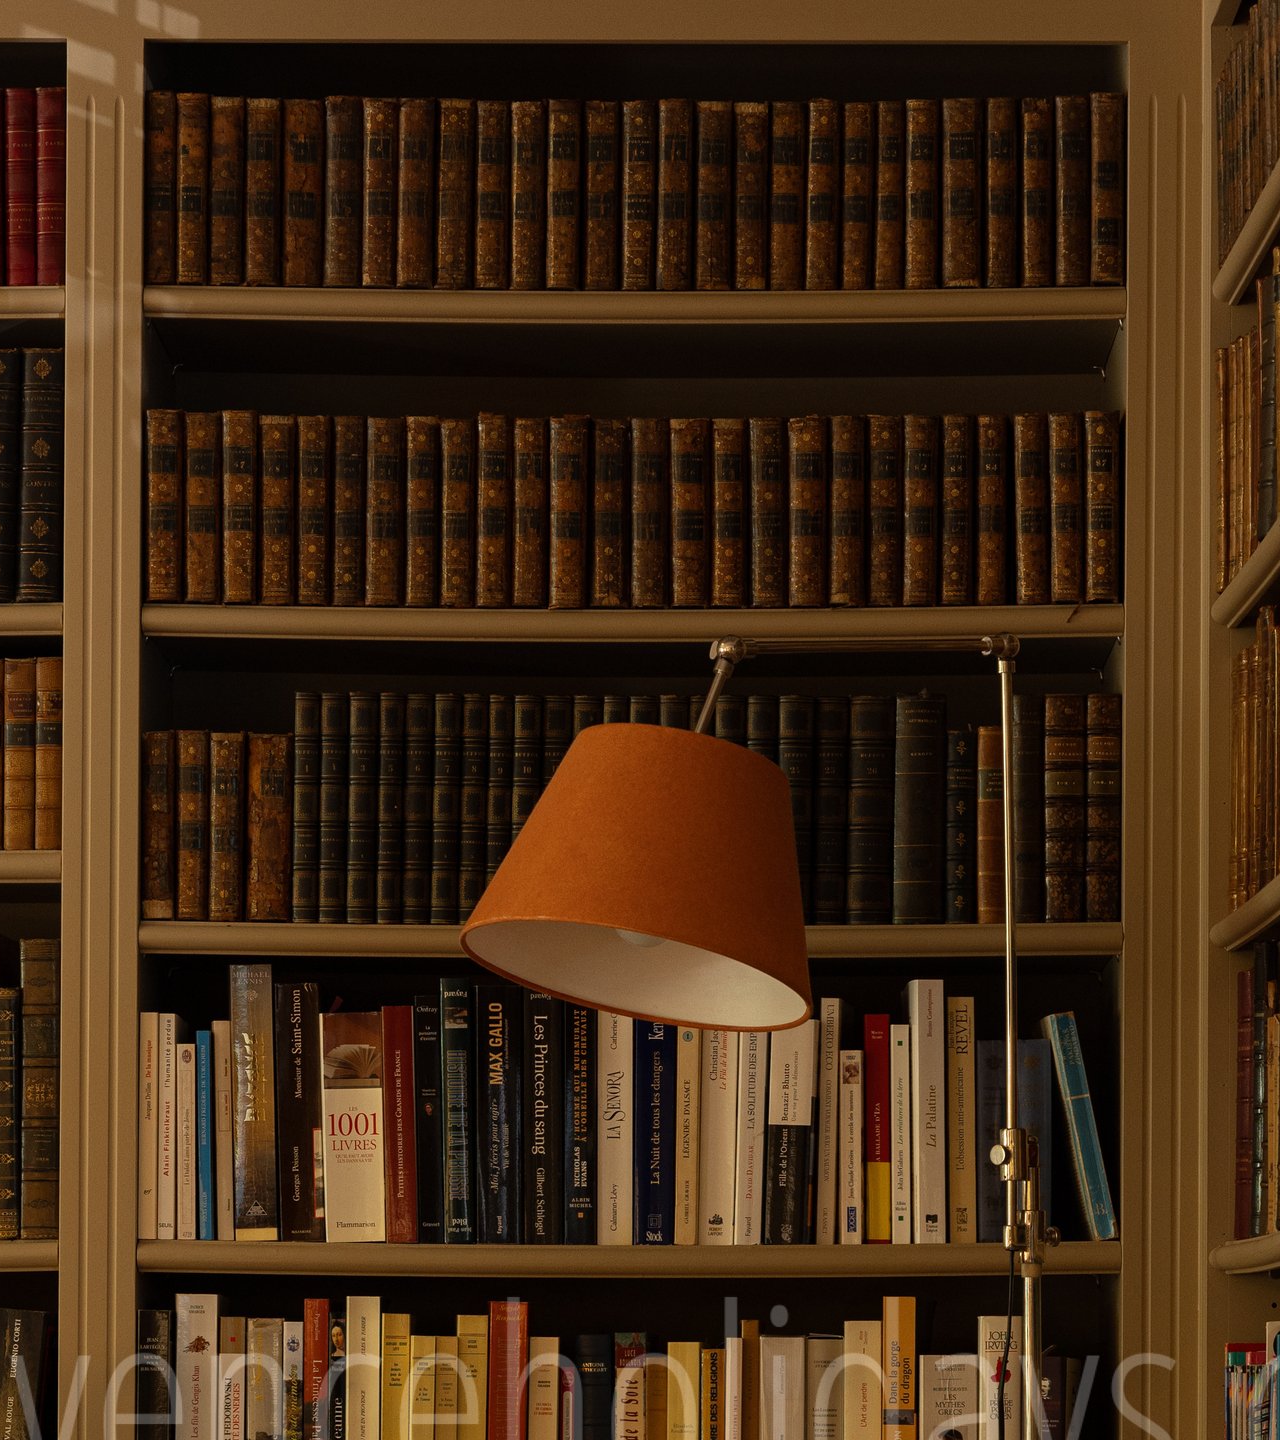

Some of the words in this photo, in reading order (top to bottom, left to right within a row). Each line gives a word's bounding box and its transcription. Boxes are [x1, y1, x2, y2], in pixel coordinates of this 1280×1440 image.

[291, 989, 302, 1054] Saint-Simon
[488, 1002, 503, 1045] GALLO
[534, 1015, 548, 1040] Les
[956, 1005, 968, 1055] REVEL
[489, 1048, 503, 1085] MAX
[534, 1044, 548, 1096] Princes
[650, 1051, 663, 1091] dangers
[782, 1063, 790, 1090] Bhutto
[294, 1067, 303, 1098] Monsieur
[395, 1079, 402, 1087] DE
[395, 1089, 403, 1117] GRANDS
[534, 1099, 548, 1117] du
[603, 1071, 626, 1122] SENORA
[650, 1093, 661, 1106] les
[683, 1079, 691, 1115] D'ALSACE
[782, 1092, 790, 1121] Benazir
[926, 1084, 937, 1130] Palatine
[955, 1067, 964, 1126] anti-américaine
[163, 1101, 171, 1151] Finkielkraut
[329, 1112, 379, 1136] 1001
[606, 1125, 621, 1139] LA
[651, 1109, 661, 1129] tous
[332, 1140, 377, 1151] LIVRES
[532, 1120, 546, 1155] sang
[650, 1132, 661, 1144] de
[681, 1118, 690, 1158] LÉGENDES
[780, 1128, 788, 1158] l'Orient
[927, 1134, 936, 1148] La
[956, 1128, 965, 1170] L'obsession
[291, 1146, 300, 1171] Poisson
[650, 1147, 661, 1169] Nuit
[780, 1160, 787, 1169] de
[292, 1174, 301, 1201] Georges
[397, 1171, 405, 1198] PETITES
[536, 1168, 546, 1197] Gilbert
[650, 1172, 661, 1184] La
[779, 1171, 787, 1187] Fille
[535, 1199, 546, 1235] Schlogel
[889, 1340, 900, 1367] gorge
[192, 1365, 200, 1381] Khan
[710, 1352, 718, 1401] RELIGIONS
[889, 1370, 898, 1378] la
[901, 1357, 912, 1390] dragon
[192, 1384, 201, 1405] Gengis
[621, 1379, 638, 1404] Soie
[889, 1382, 898, 1404] Dans
[901, 1392, 910, 1404] du
[191, 1406, 199, 1414] de
[191, 1415, 199, 1425] fils
[224, 1377, 232, 1436] FEDOROVSKI
[621, 1410, 638, 1422] la
[710, 1403, 718, 1422] DES
[191, 1426, 199, 1438] Les
